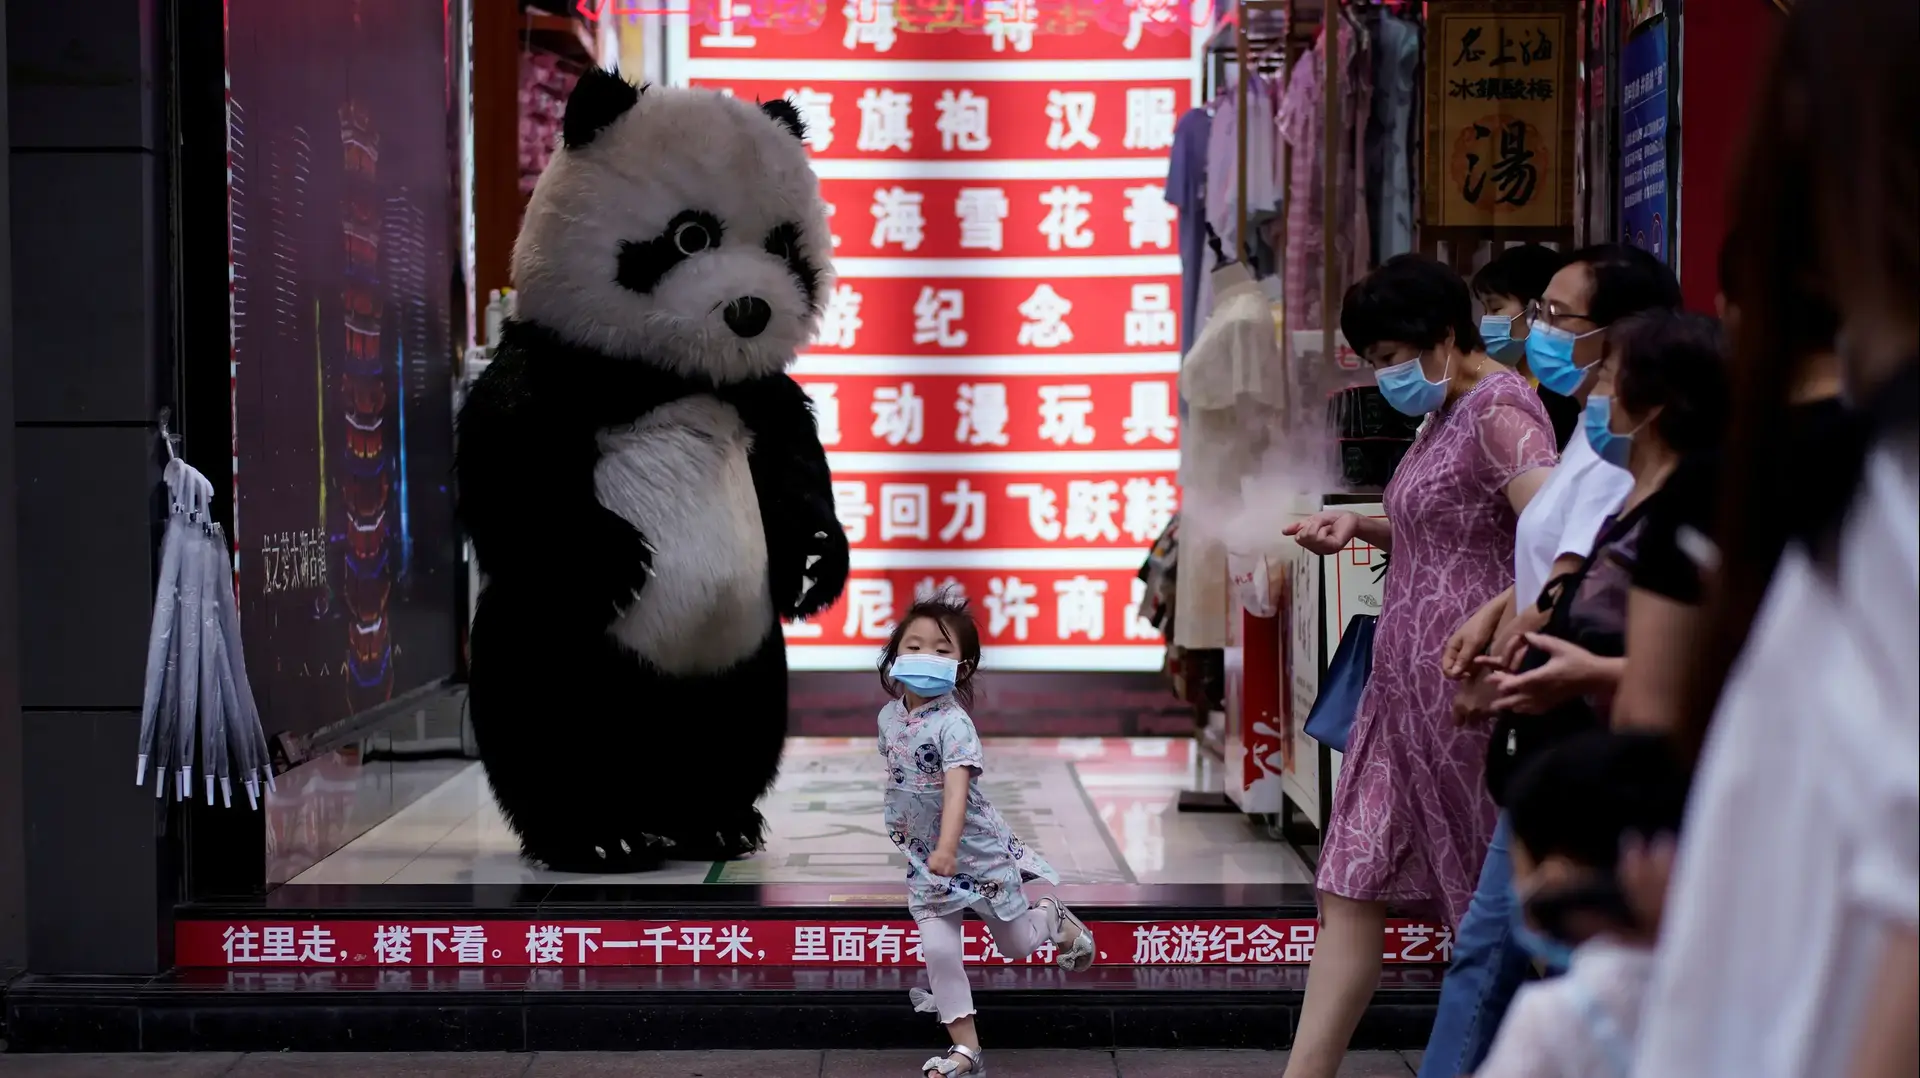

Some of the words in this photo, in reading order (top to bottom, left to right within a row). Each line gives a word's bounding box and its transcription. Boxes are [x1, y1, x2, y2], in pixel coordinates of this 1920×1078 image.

[784, 88, 1176, 152] 海旗袍汉服
[1463, 120, 1536, 206] 湯
[824, 186, 1178, 251] 海雪花膏
